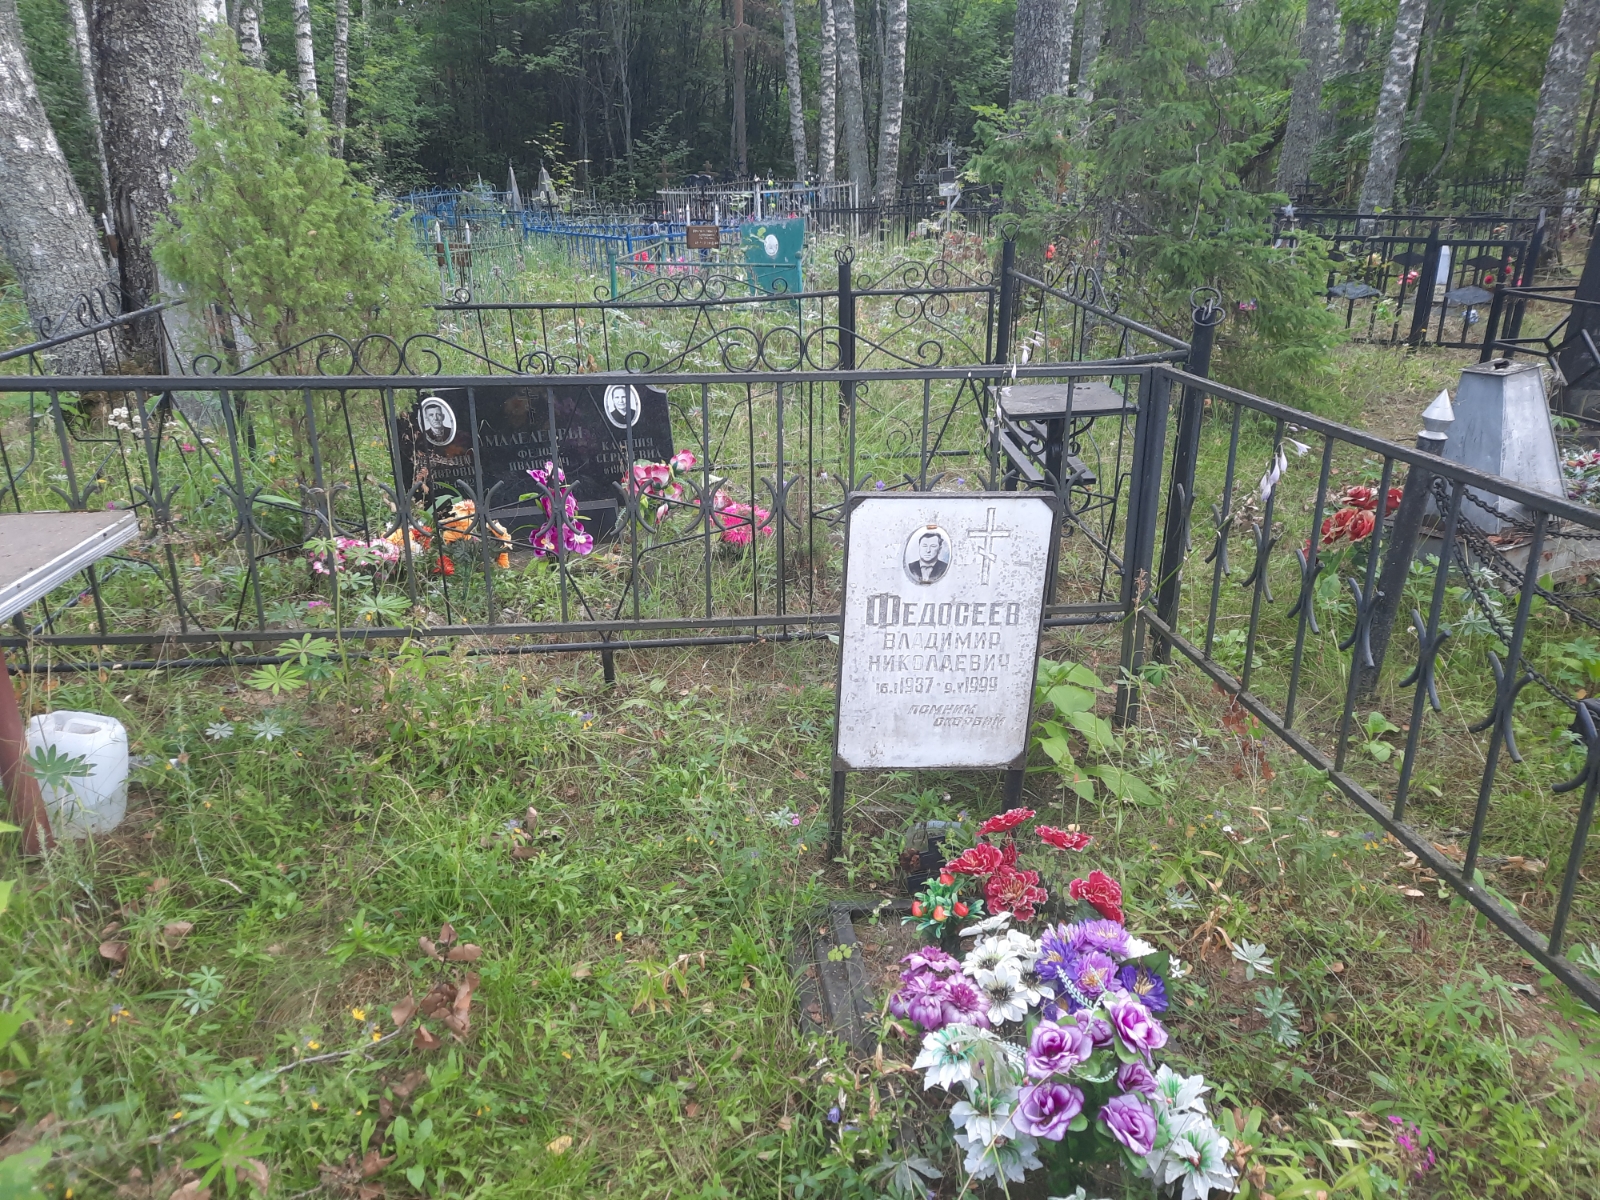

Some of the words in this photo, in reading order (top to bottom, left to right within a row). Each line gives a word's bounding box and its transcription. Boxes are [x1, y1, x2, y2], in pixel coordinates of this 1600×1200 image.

[866, 593, 1020, 628] ФЕДОСЕЕВ
[883, 632, 1001, 650] ВЛАДИМИР
[868, 653, 1010, 672] НИКОЛАЕВИЧ
